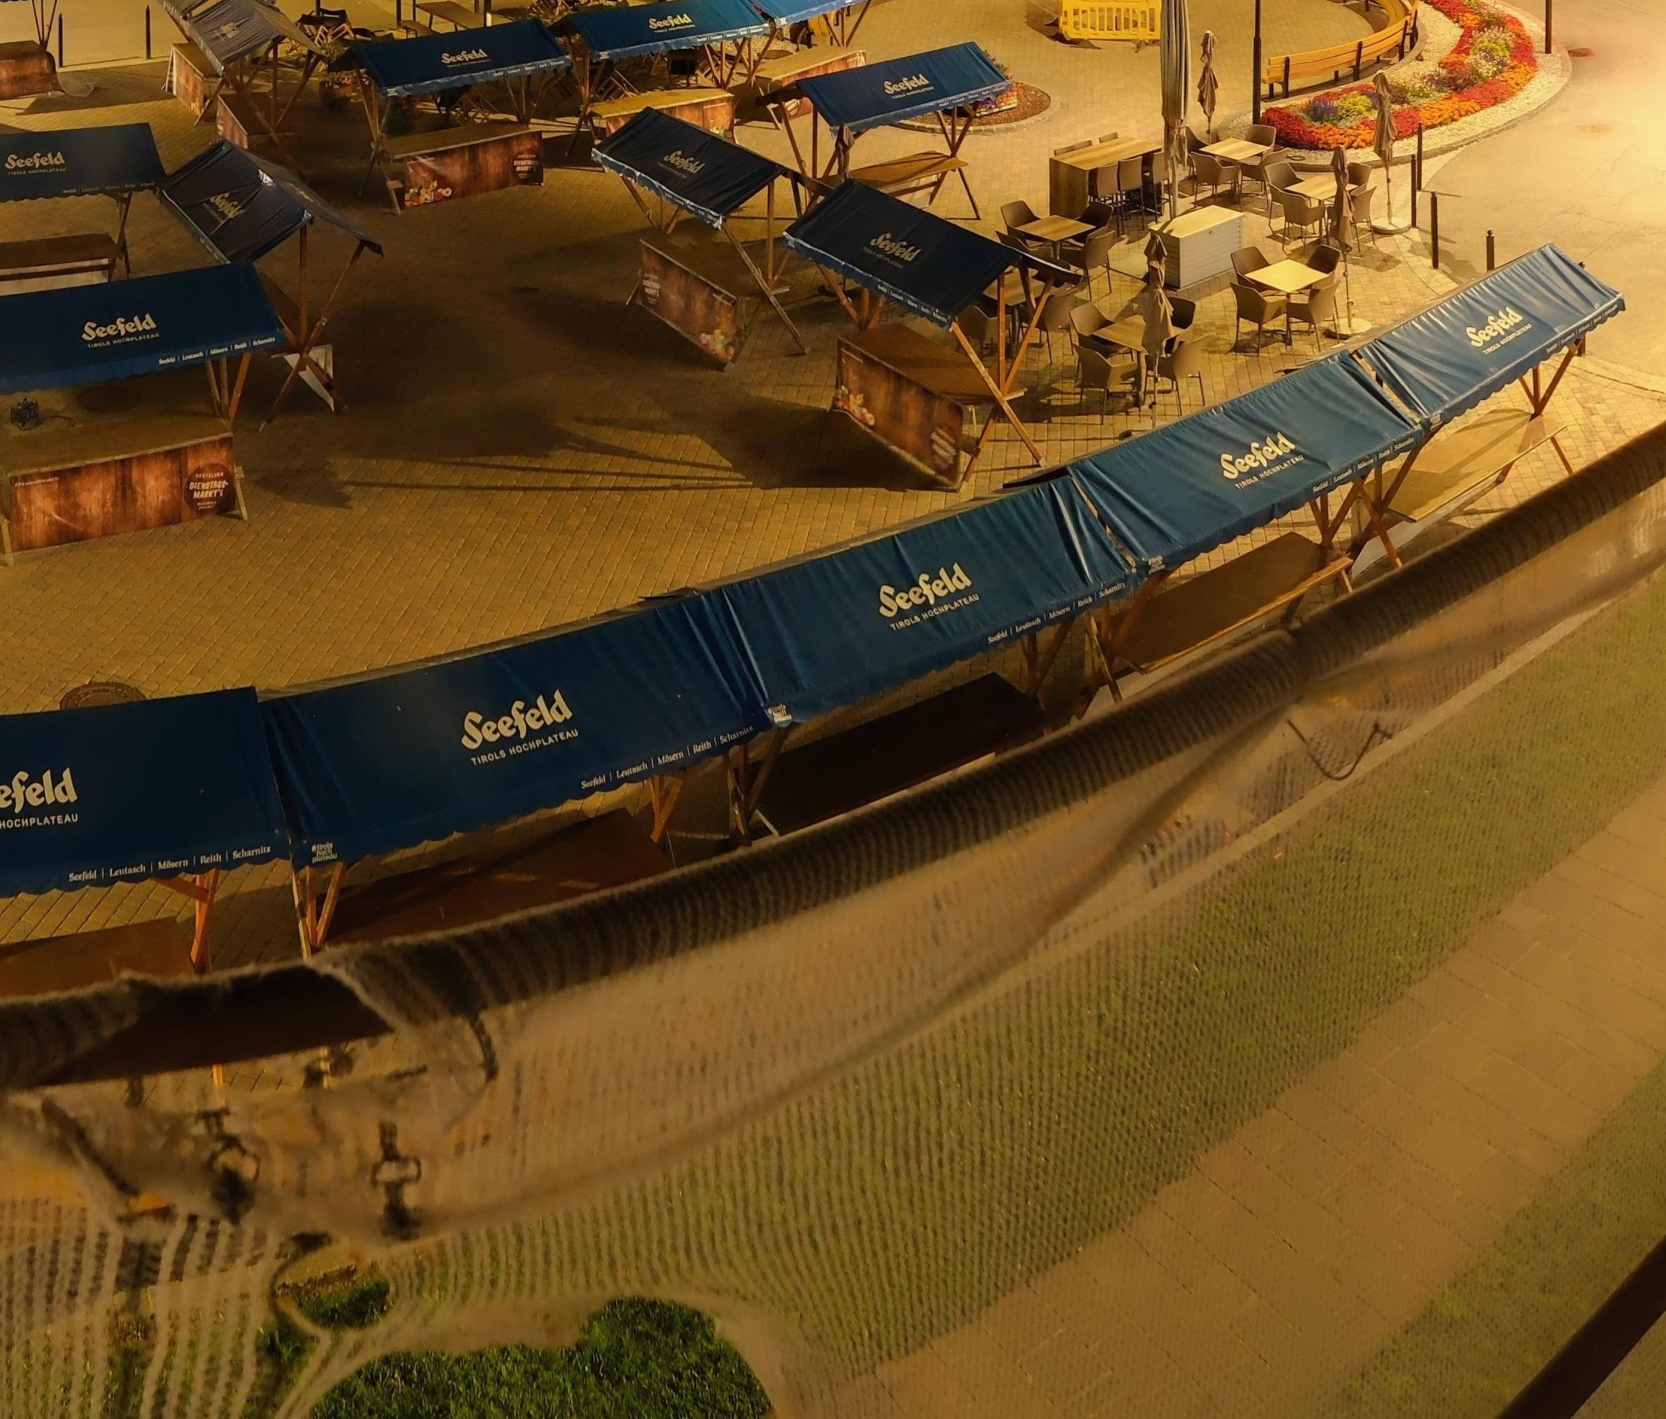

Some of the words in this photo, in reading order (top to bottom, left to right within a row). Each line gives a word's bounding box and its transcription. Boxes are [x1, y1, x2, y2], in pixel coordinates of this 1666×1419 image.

[648, 13, 693, 30] Seefeld
[441, 47, 488, 65] Seefeld
[883, 72, 929, 95] Seefeld
[4, 151, 66, 170] Seefeld
[663, 149, 707, 175] Seefeld
[869, 231, 923, 263] Seefeld
[81, 313, 157, 341] Seefeld
[1465, 305, 1523, 349] Seefeld
[87, 339, 111, 349] TIROLS
[1220, 431, 1297, 480] Seefeld
[189, 480, 229, 491] DIENSTAGS-
[1234, 475, 1259, 491] TIROLS
[1259, 455, 1304, 479] HOCHPLATEAU
[878, 561, 972, 618] Seefeld
[889, 615, 921, 633] TIROLS
[921, 593, 980, 621] HOCHPLATEAU
[987, 629, 1009, 645] Seefeld
[1014, 617, 1042, 635] Leutasch
[461, 688, 574, 751] Seefeld
[470, 749, 507, 767] TIROLS
[509, 729, 580, 757] HOCHPLATEAU
[581, 774, 607, 790] Seefeld
[615, 761, 649, 781] Leutasch
[657, 749, 685, 767] Mösern
[692, 739, 713, 755] Reith
[719, 725, 754, 746] Scharnitz
[68, 869, 97, 883] Seefeld
[109, 863, 146, 879] Leutasch
[157, 855, 189, 872] Mösern
[199, 851, 222, 865] Reith
[231, 843, 271, 861] Scharnitz
